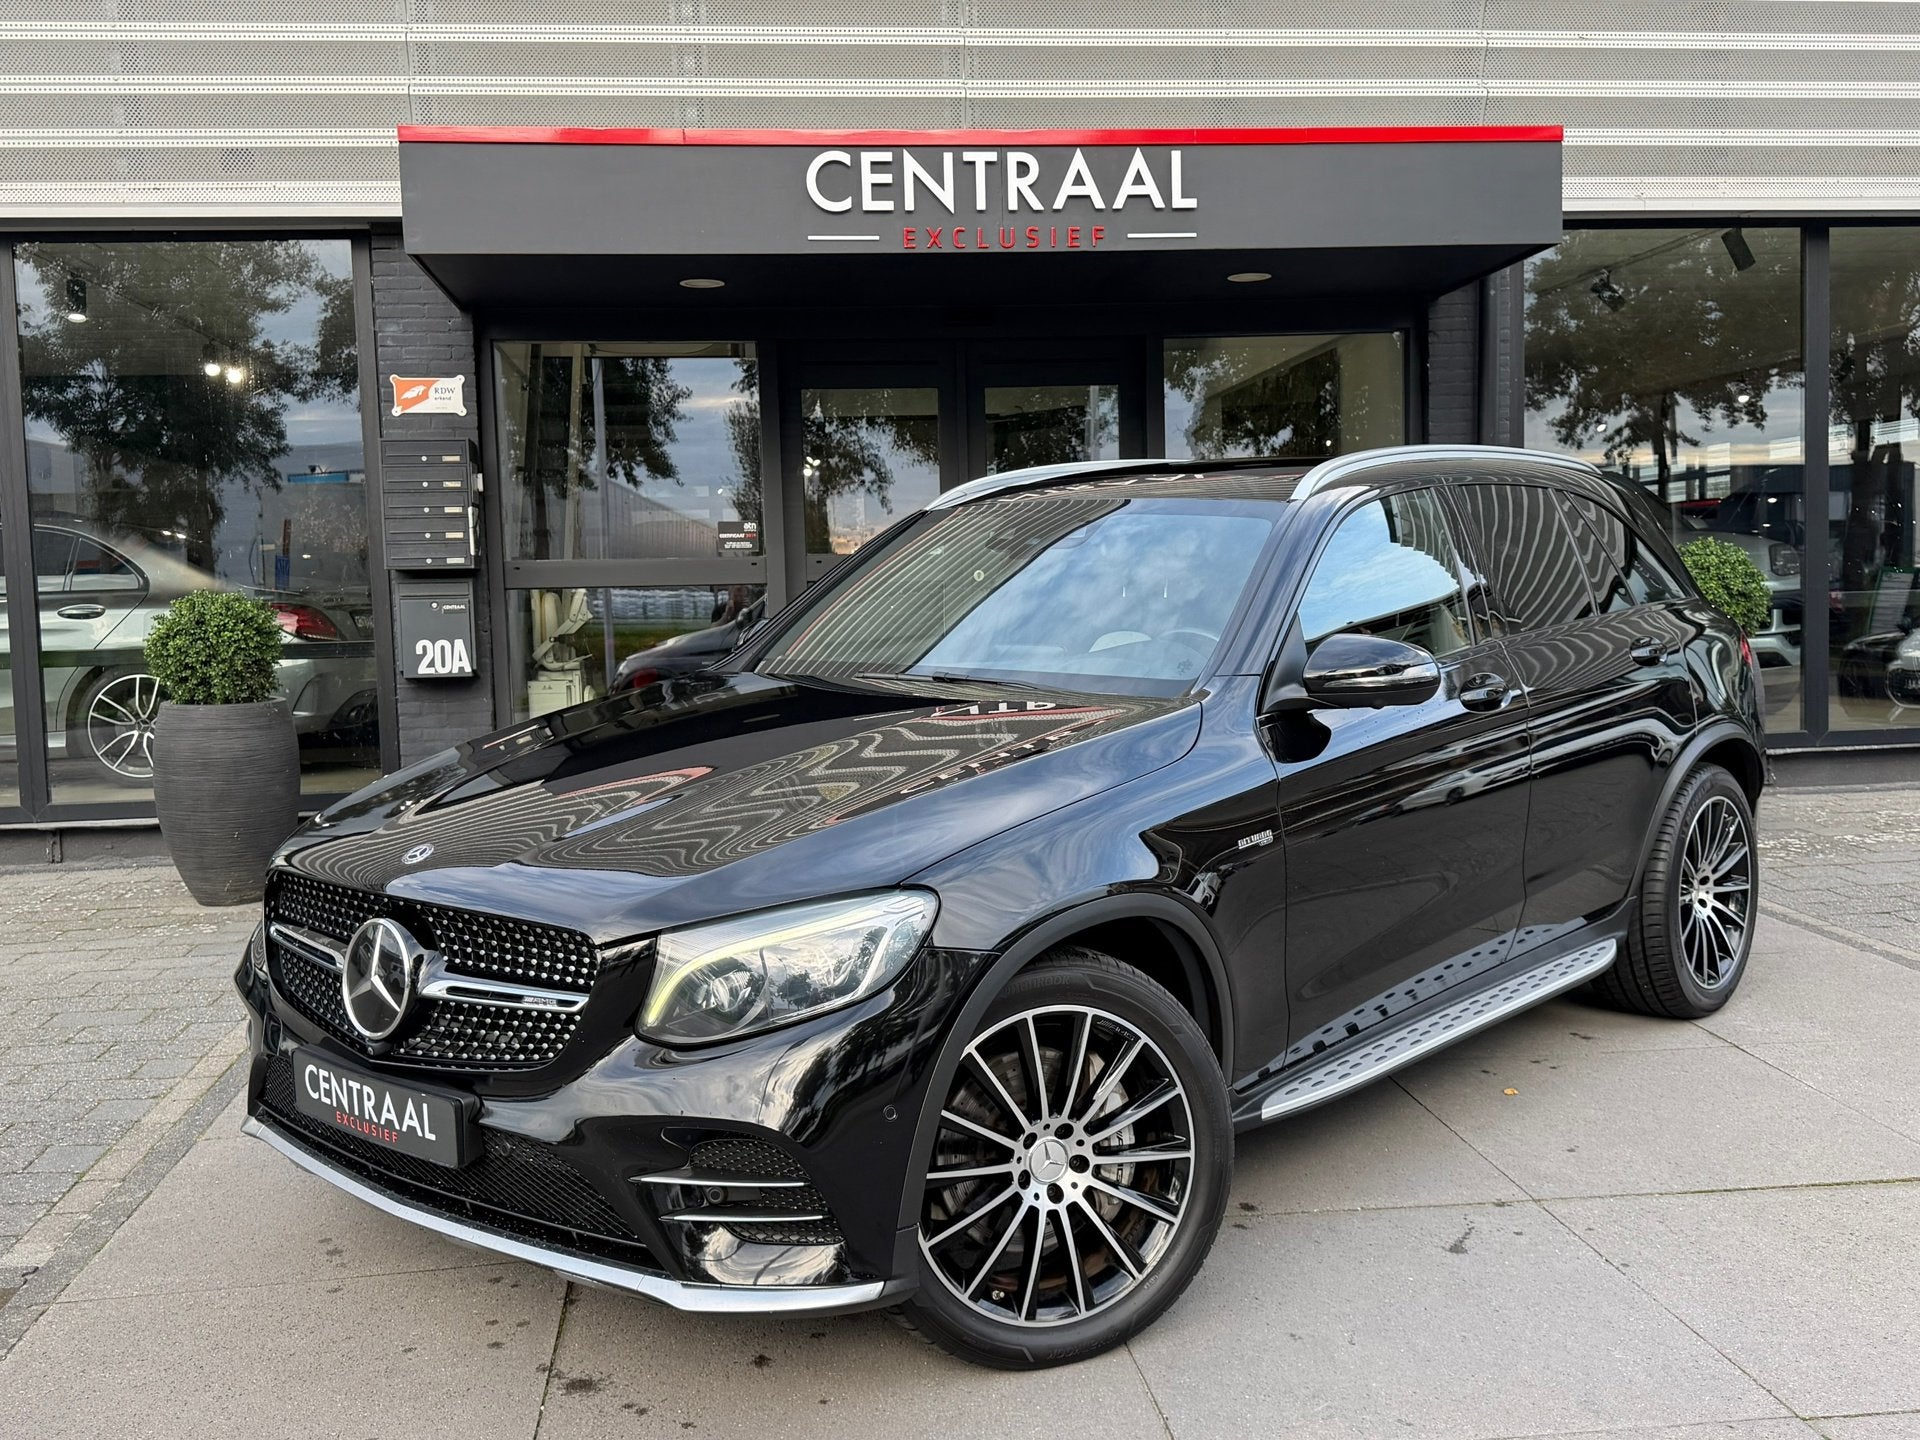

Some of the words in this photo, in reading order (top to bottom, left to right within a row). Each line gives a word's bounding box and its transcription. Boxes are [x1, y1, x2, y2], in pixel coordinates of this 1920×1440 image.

[806, 147, 1198, 214] CENTRAAL
[903, 226, 1105, 249] EXCLUSIEF
[415, 638, 472, 674] 20A
[304, 1064, 437, 1141] CENTRAAL
[335, 1110, 399, 1144] EXCLUSIEF
